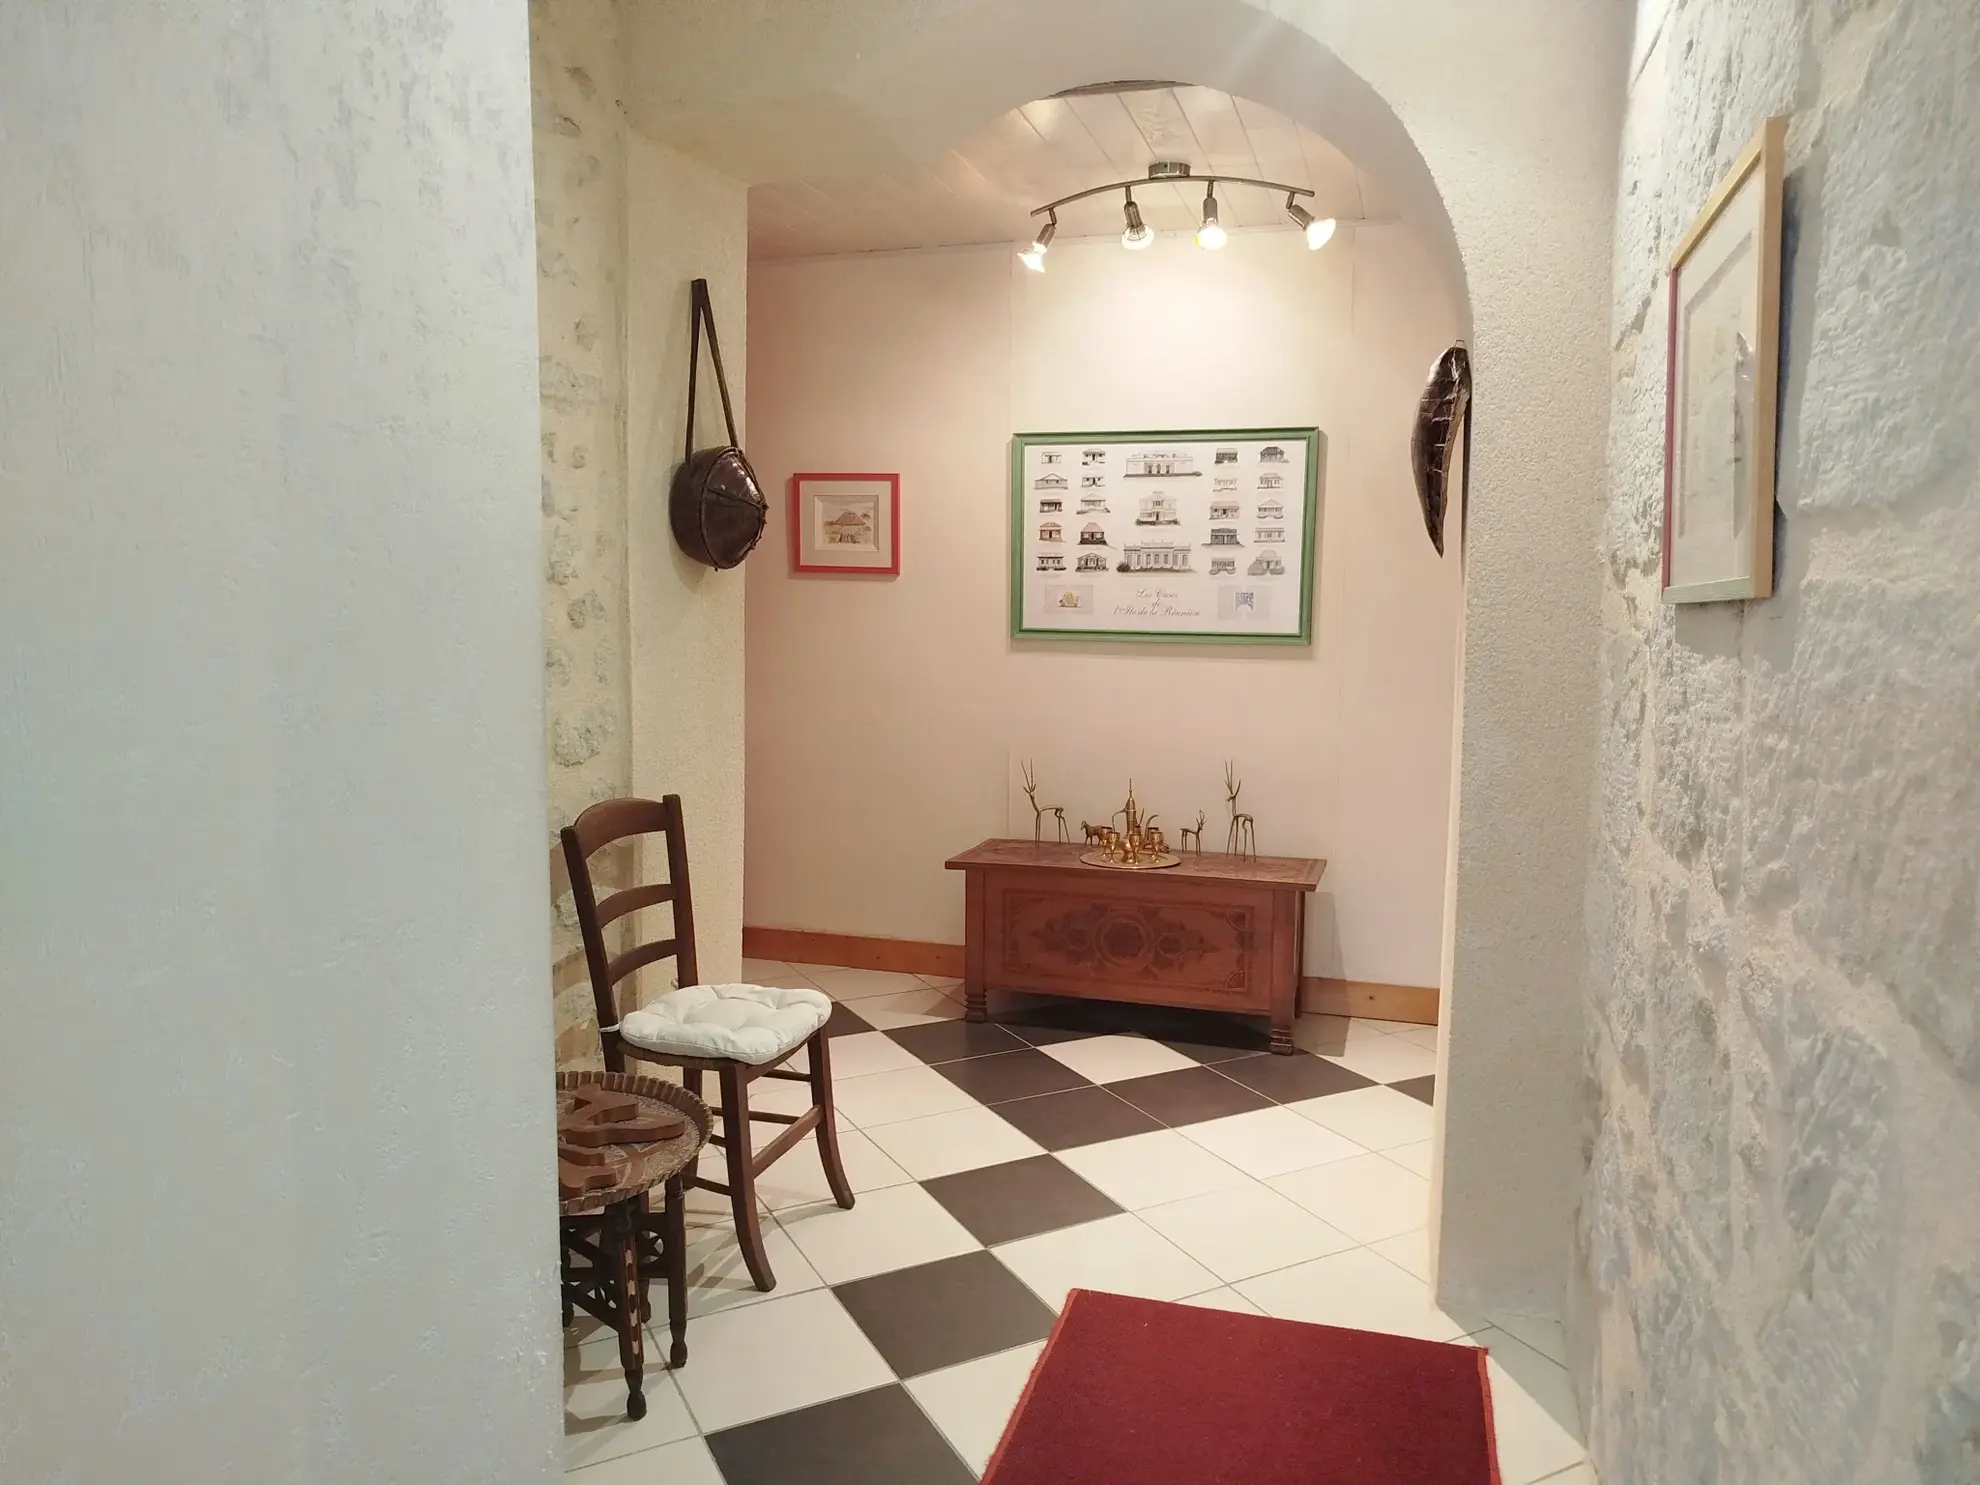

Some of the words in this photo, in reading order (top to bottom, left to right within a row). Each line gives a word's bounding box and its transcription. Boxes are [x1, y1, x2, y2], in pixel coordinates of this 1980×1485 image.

[1136, 587, 1152, 598] Les
[1155, 587, 1178, 598] Cases
[1138, 606, 1148, 615] de
[1149, 606, 1158, 615] la
[1159, 605, 1201, 616] Réunion
